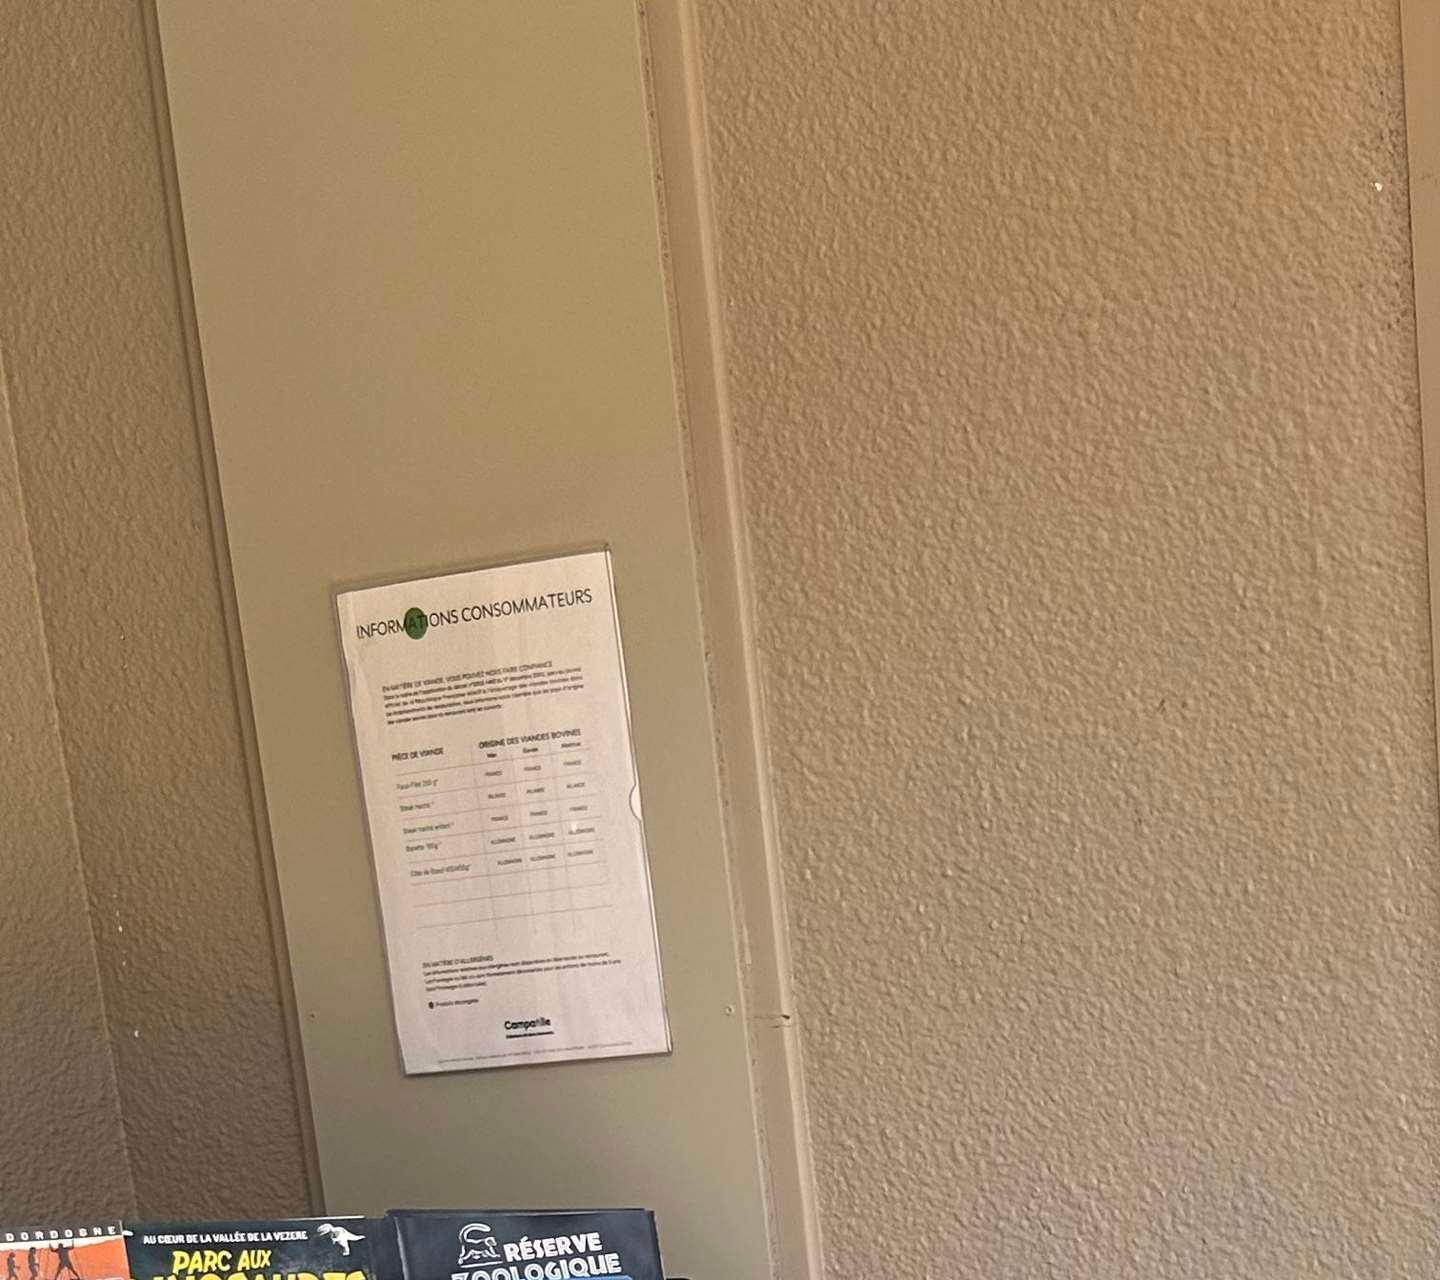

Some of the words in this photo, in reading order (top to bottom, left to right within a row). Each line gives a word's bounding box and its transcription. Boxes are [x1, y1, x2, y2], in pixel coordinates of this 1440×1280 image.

[356, 608, 459, 640] INFORMATIONS
[461, 588, 592, 623] CONSOMMATEURS
[507, 736, 519, 745] DES
[520, 733, 550, 744] VIANDES
[5, 1226, 116, 1241] DORDOGNE
[143, 1235, 156, 1245] AU
[186, 1234, 198, 1244] DE
[200, 1233, 211, 1243] LA
[248, 1232, 260, 1242] DE
[261, 1232, 272, 1241] LA
[503, 1232, 603, 1262] RÉSERVE
[172, 1250, 232, 1273] PARC
[238, 1250, 272, 1271] AUX
